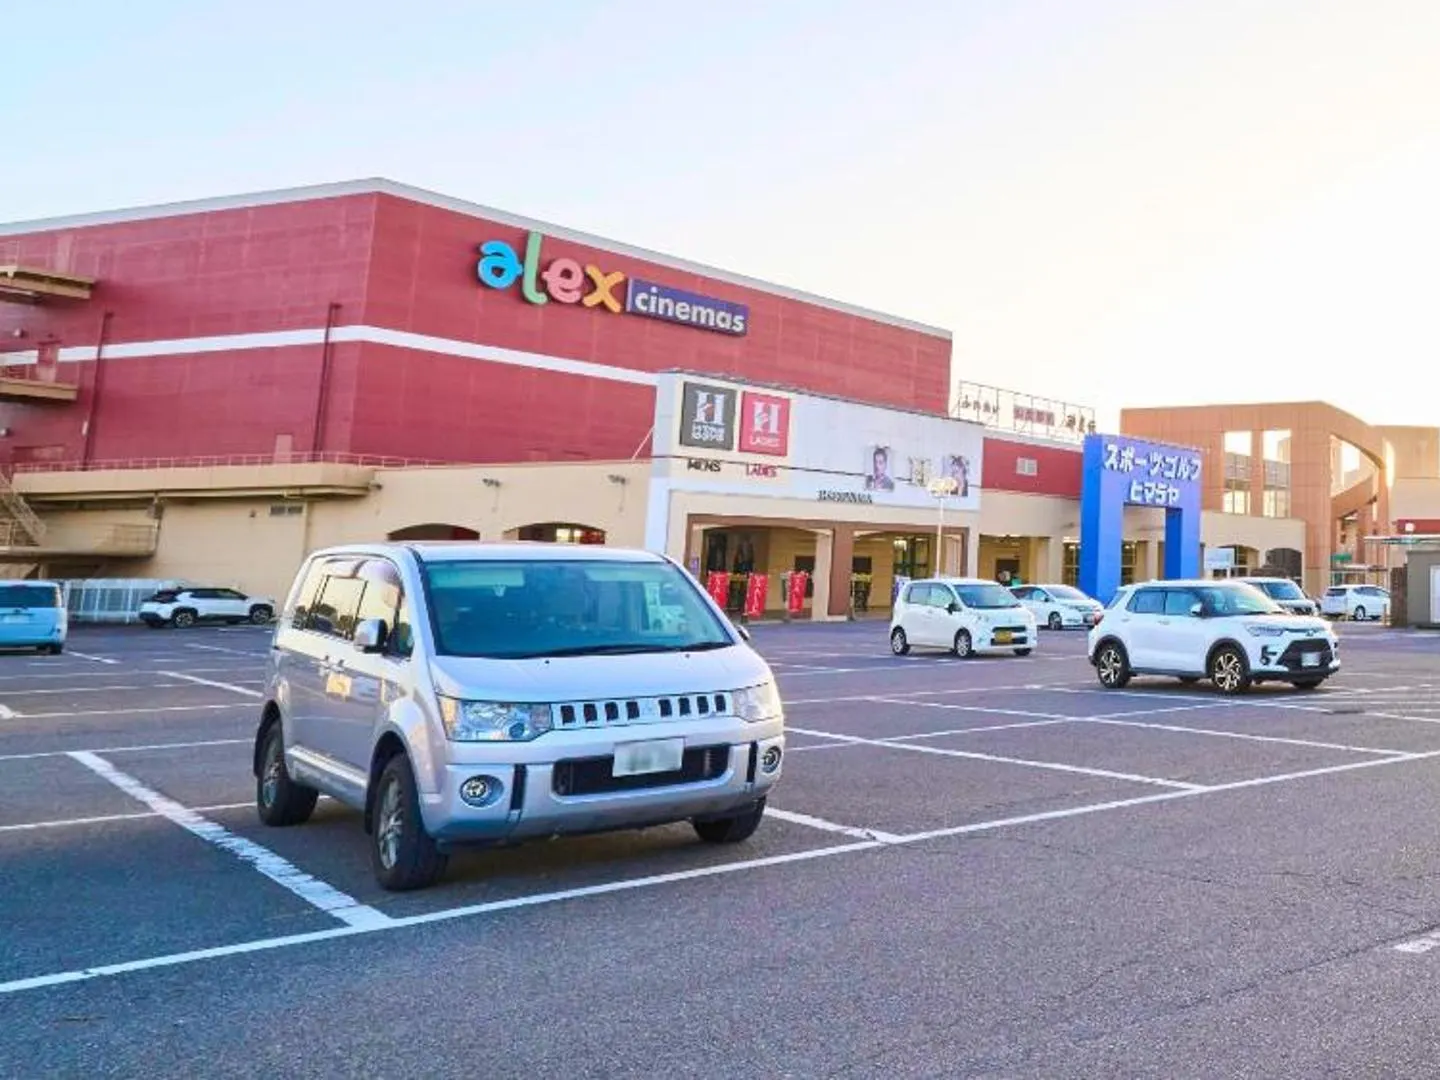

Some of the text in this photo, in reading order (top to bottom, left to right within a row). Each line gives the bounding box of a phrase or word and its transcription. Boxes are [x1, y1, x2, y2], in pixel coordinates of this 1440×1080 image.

[477, 231, 746, 335] alex cinemas
[1130, 482, 1181, 505] ヒマラヤ
